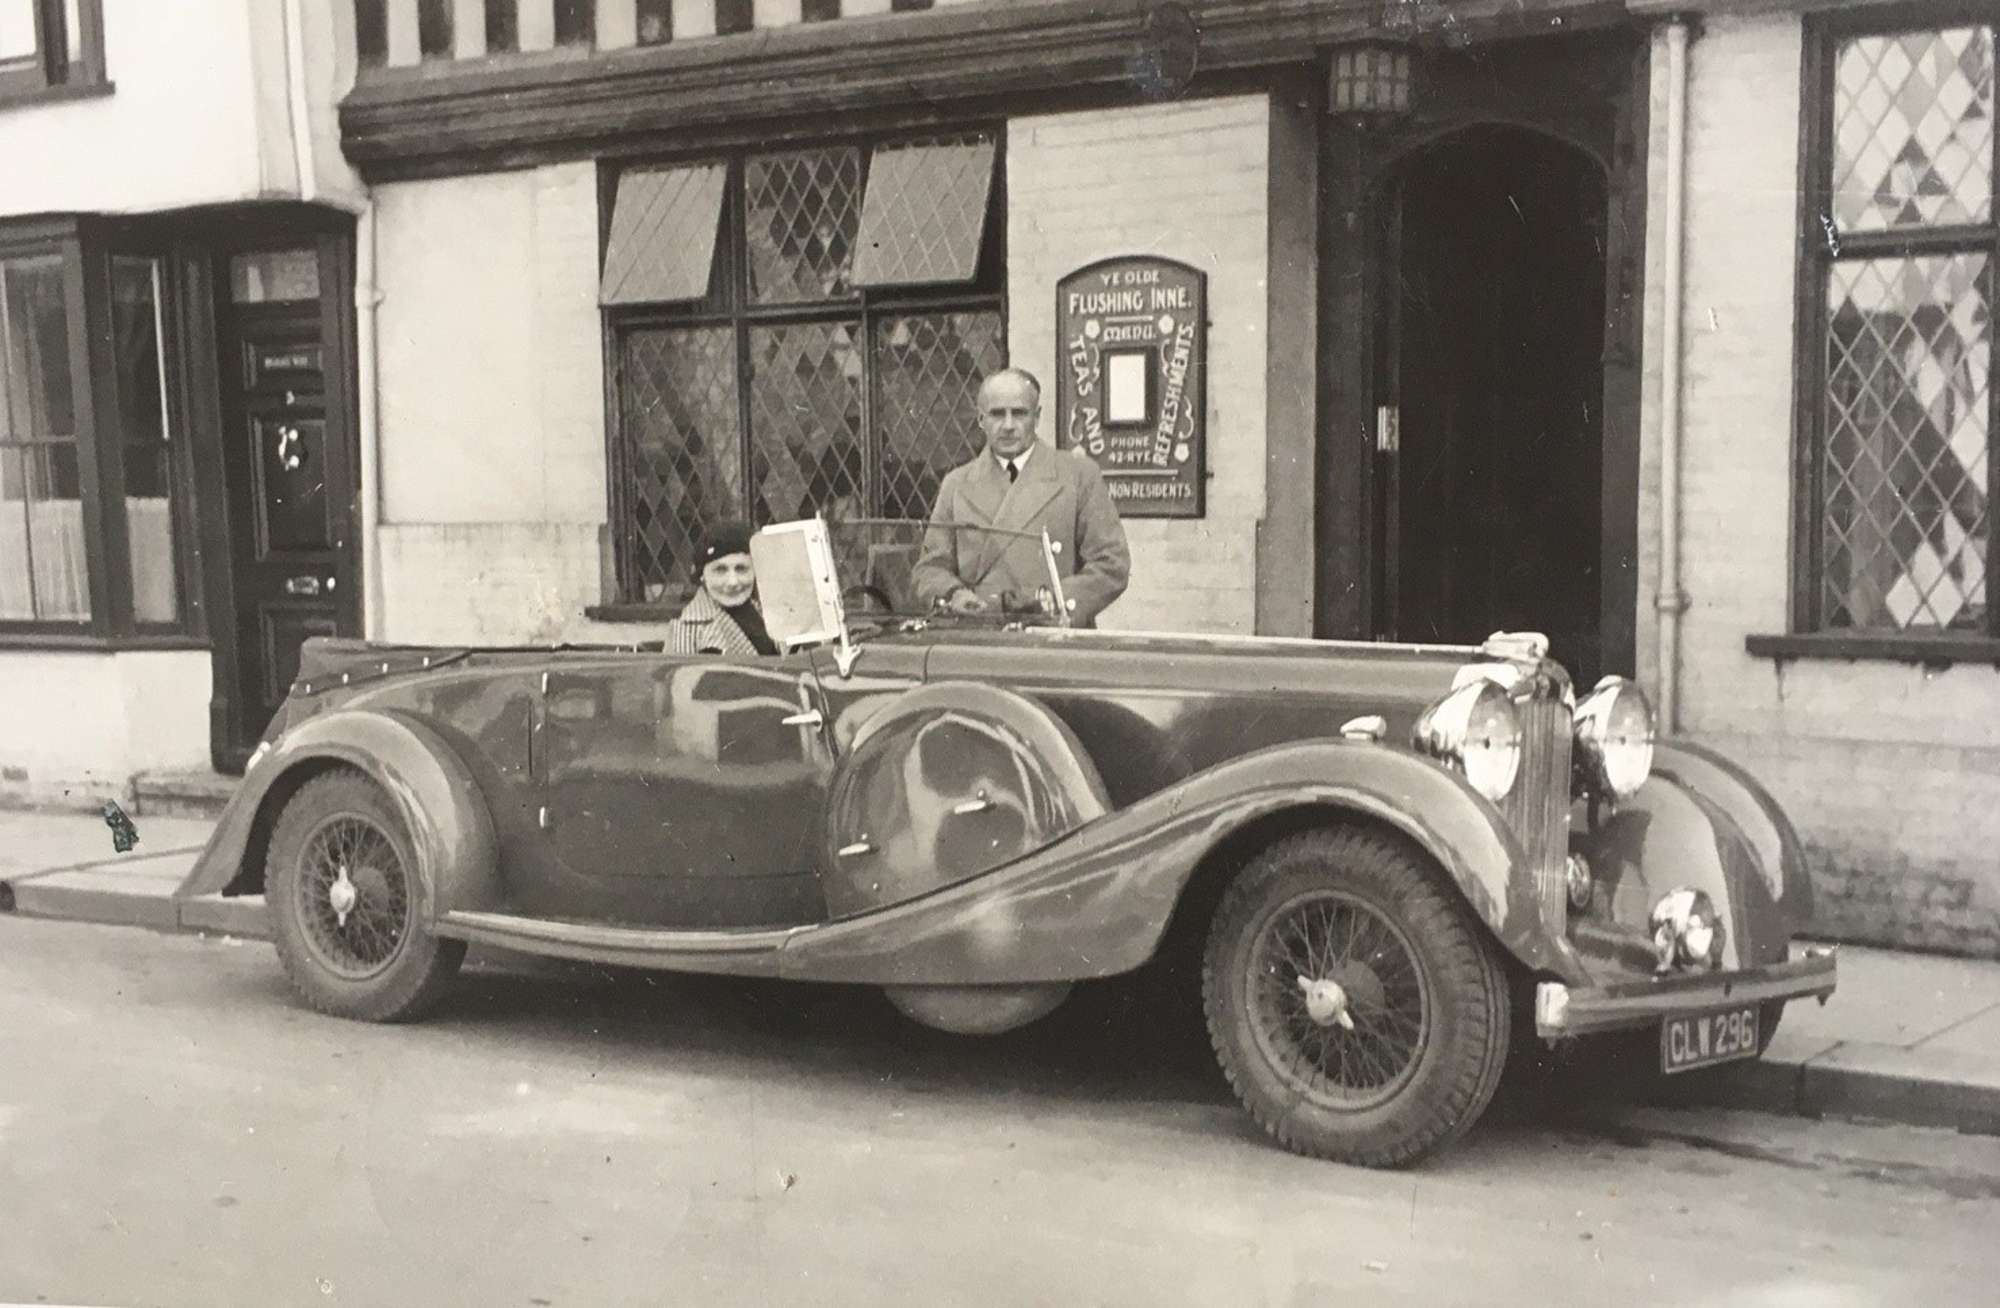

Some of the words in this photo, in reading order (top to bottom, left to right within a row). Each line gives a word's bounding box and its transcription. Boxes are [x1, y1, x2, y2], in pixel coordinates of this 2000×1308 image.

[1101, 271, 1119, 286] YE
[1125, 269, 1160, 284] OLDE
[1069, 290, 1143, 314] FLUSHING
[1070, 334, 1093, 396] TEAS
[1082, 407, 1105, 455] AND
[1111, 436, 1149, 448] PHONE
[1671, 1017, 1710, 1062] CLW
[1715, 1009, 1752, 1054] 296
